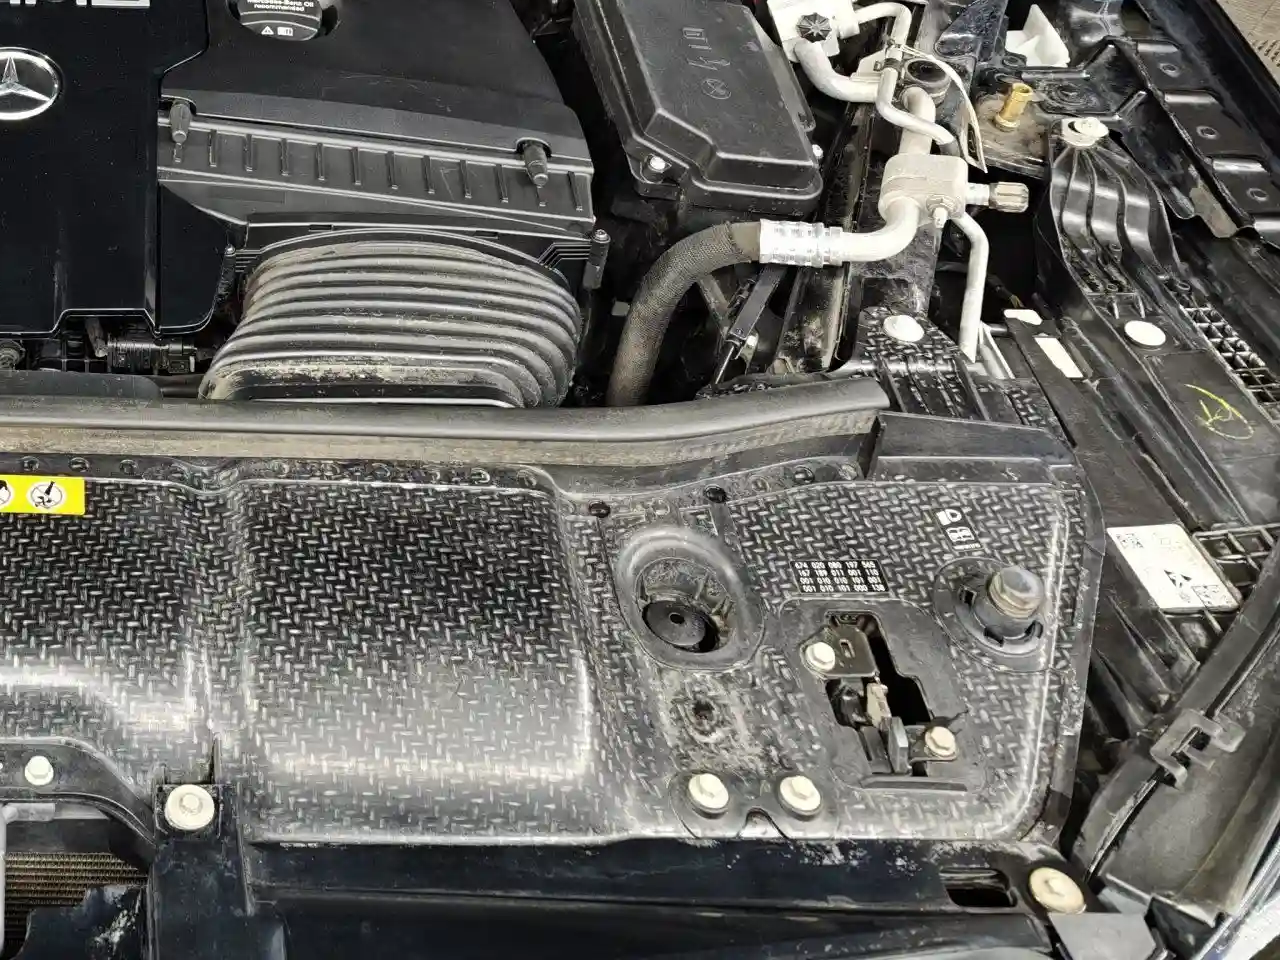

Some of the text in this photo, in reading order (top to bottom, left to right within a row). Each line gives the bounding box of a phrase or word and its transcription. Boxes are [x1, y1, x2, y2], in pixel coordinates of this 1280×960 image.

[254, 4, 305, 12] recommended
[831, 569, 844, 577] 011
[820, 584, 834, 592] 010
